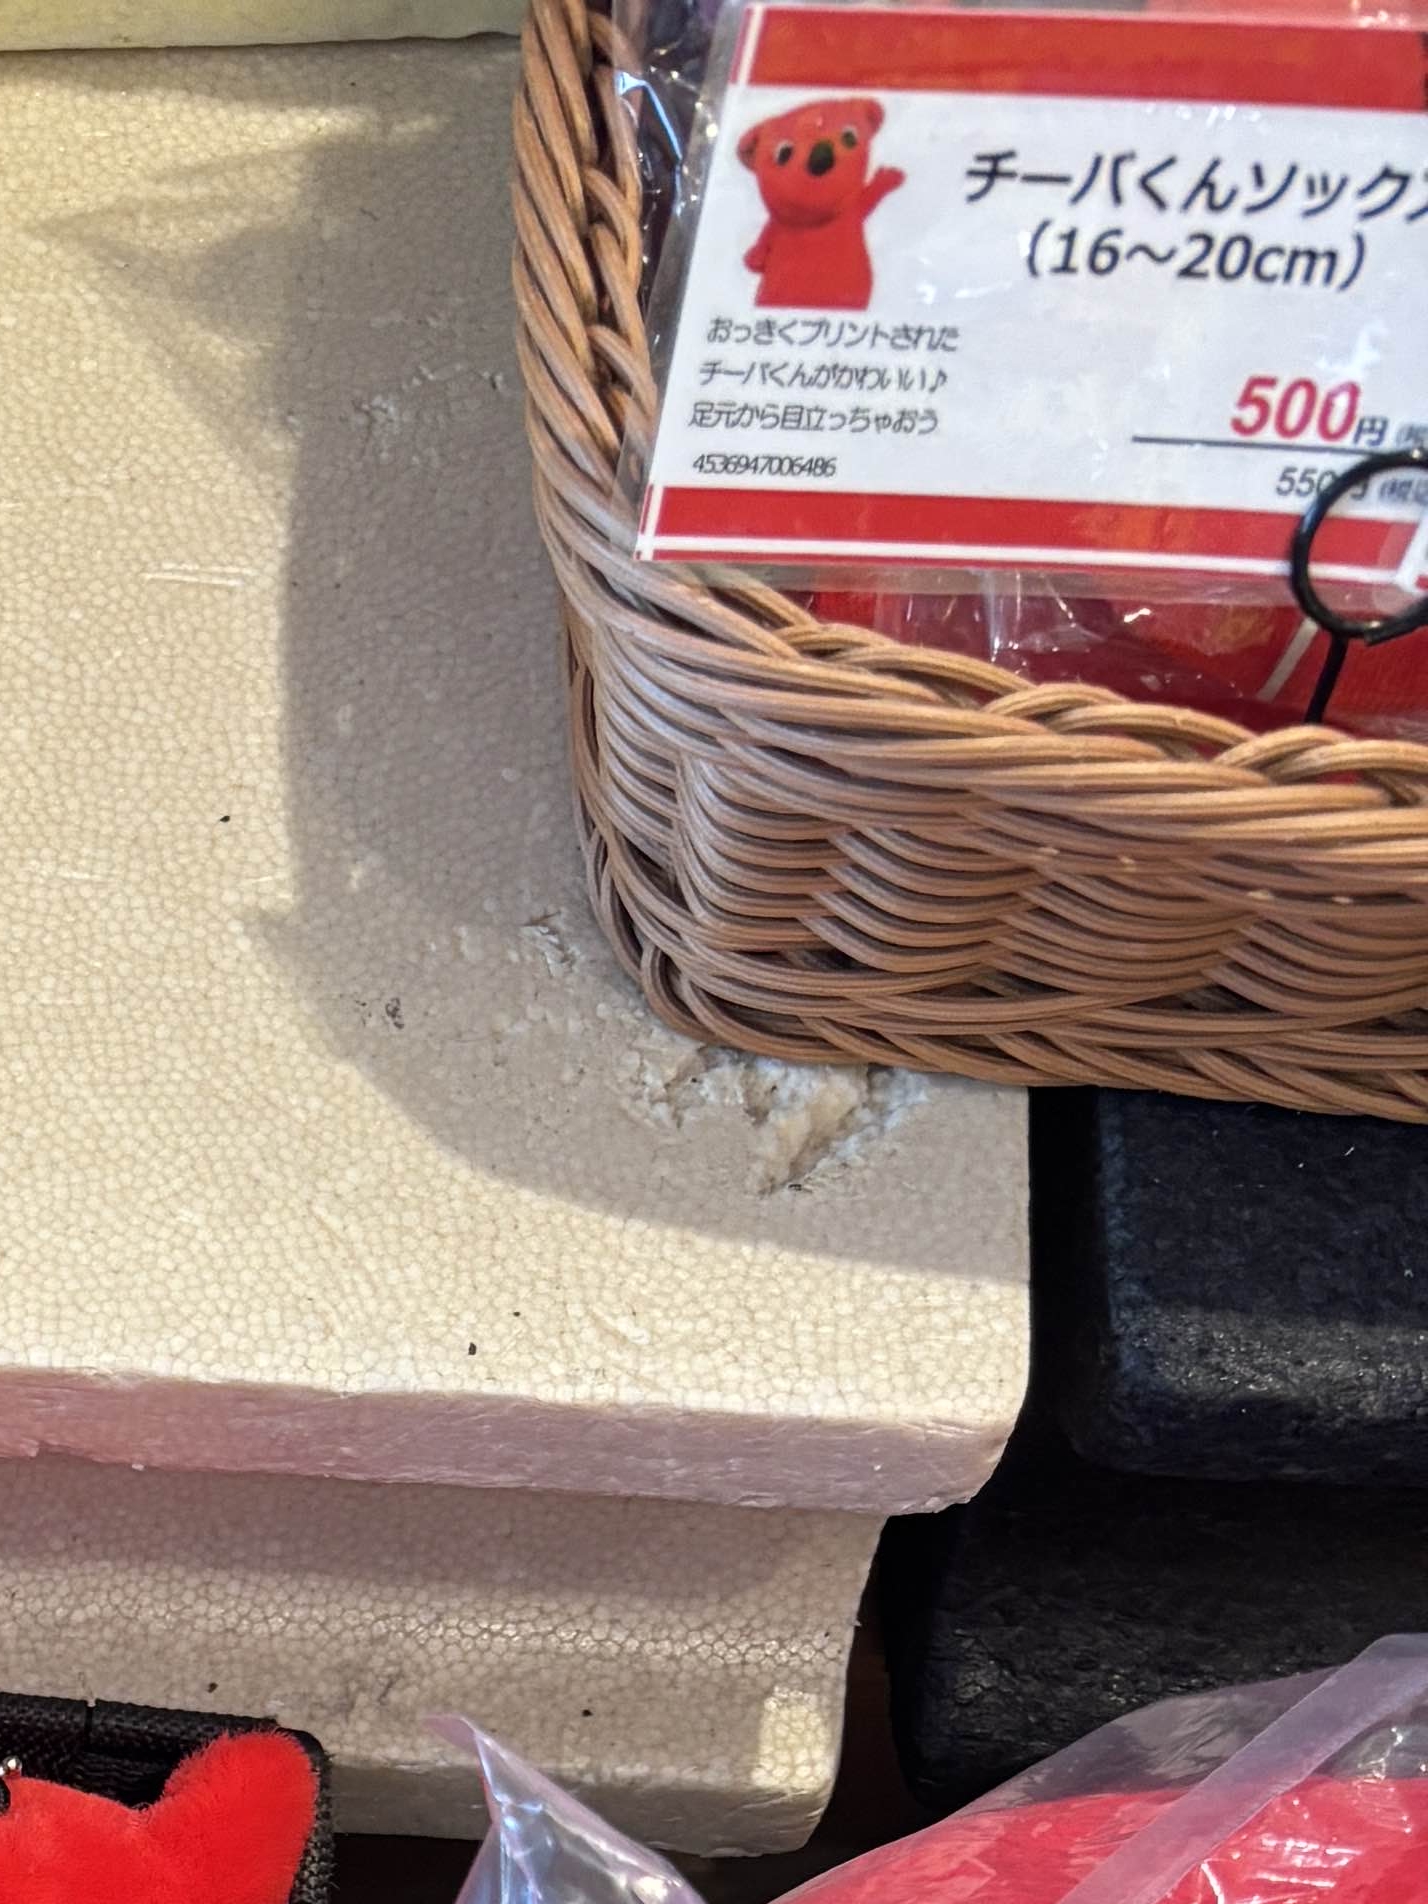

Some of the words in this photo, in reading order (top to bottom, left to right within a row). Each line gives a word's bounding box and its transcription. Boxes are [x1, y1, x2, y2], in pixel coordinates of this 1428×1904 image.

[706, 316, 960, 351] おっきくプリントされた
[688, 401, 939, 435] 足元から目立っちゃおう
[692, 452, 837, 477] 4536947006486
